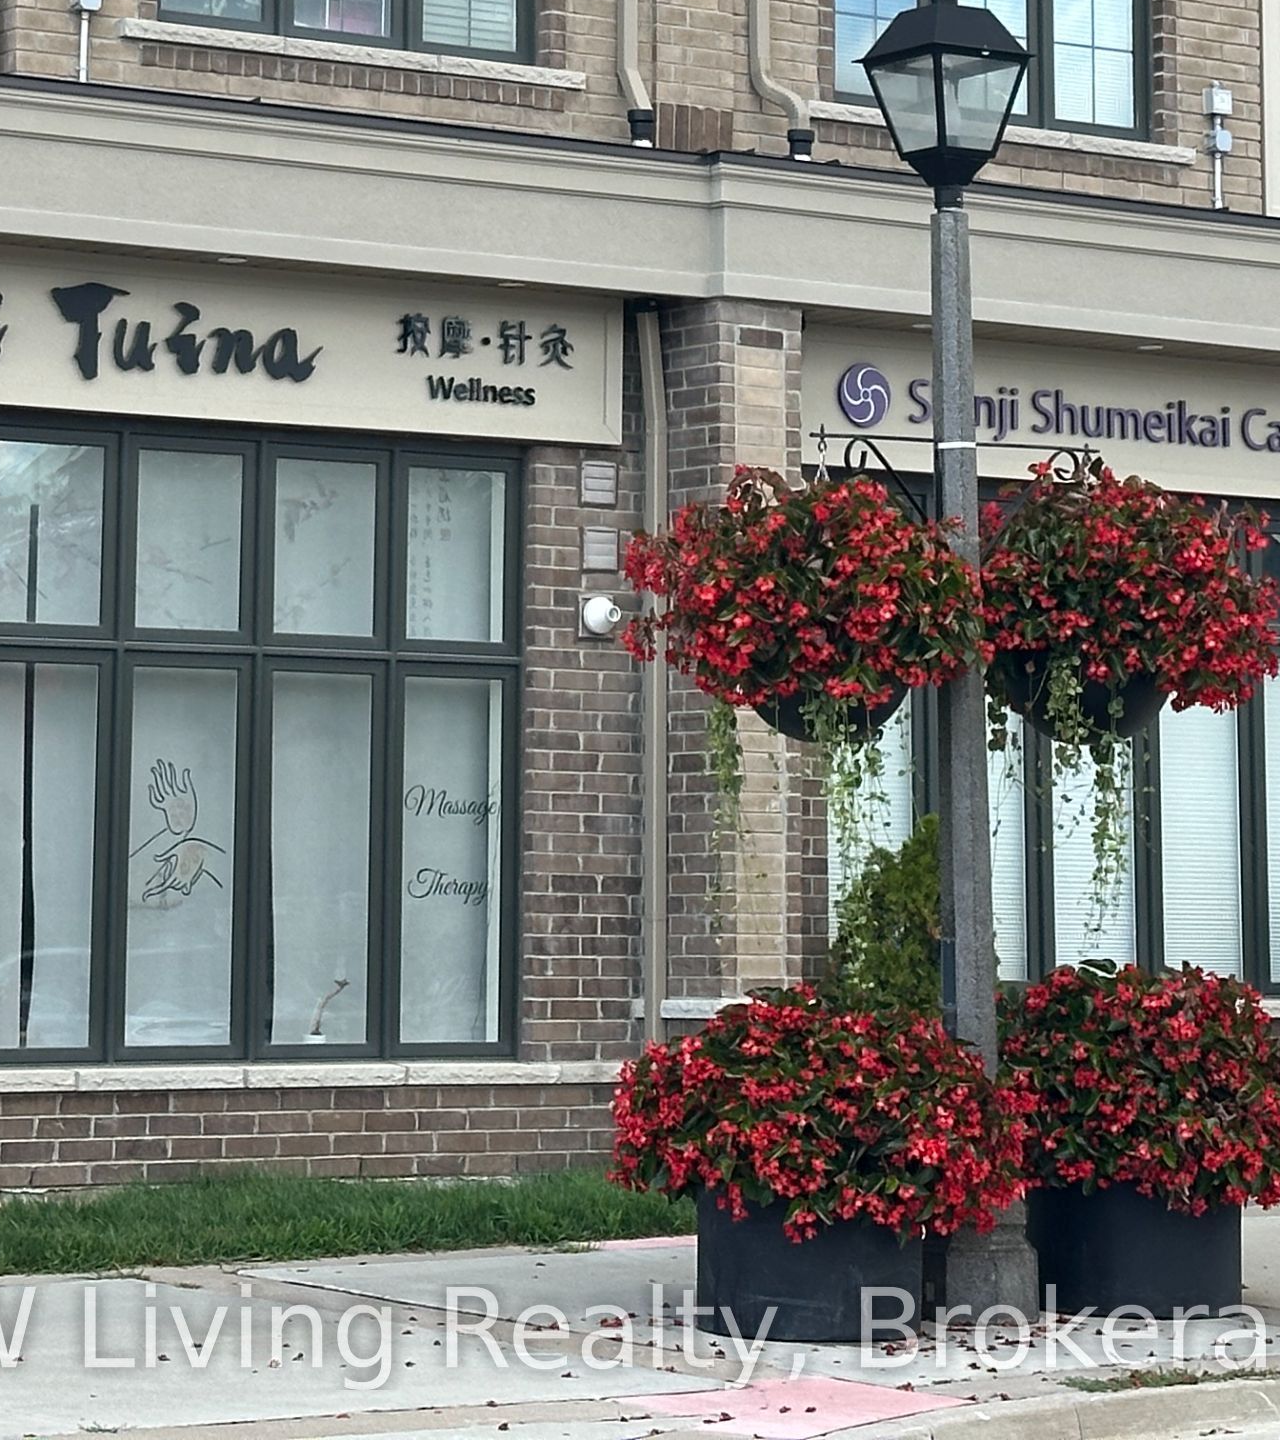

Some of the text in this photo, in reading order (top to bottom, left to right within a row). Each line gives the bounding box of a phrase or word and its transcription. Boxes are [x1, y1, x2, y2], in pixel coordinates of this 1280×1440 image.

[51, 282, 324, 383] Tuina
[426, 375, 536, 407] Wellness
[1031, 389, 1230, 448] Shumeikai
[404, 785, 497, 825] Massage
[408, 868, 489, 905] Therapy
